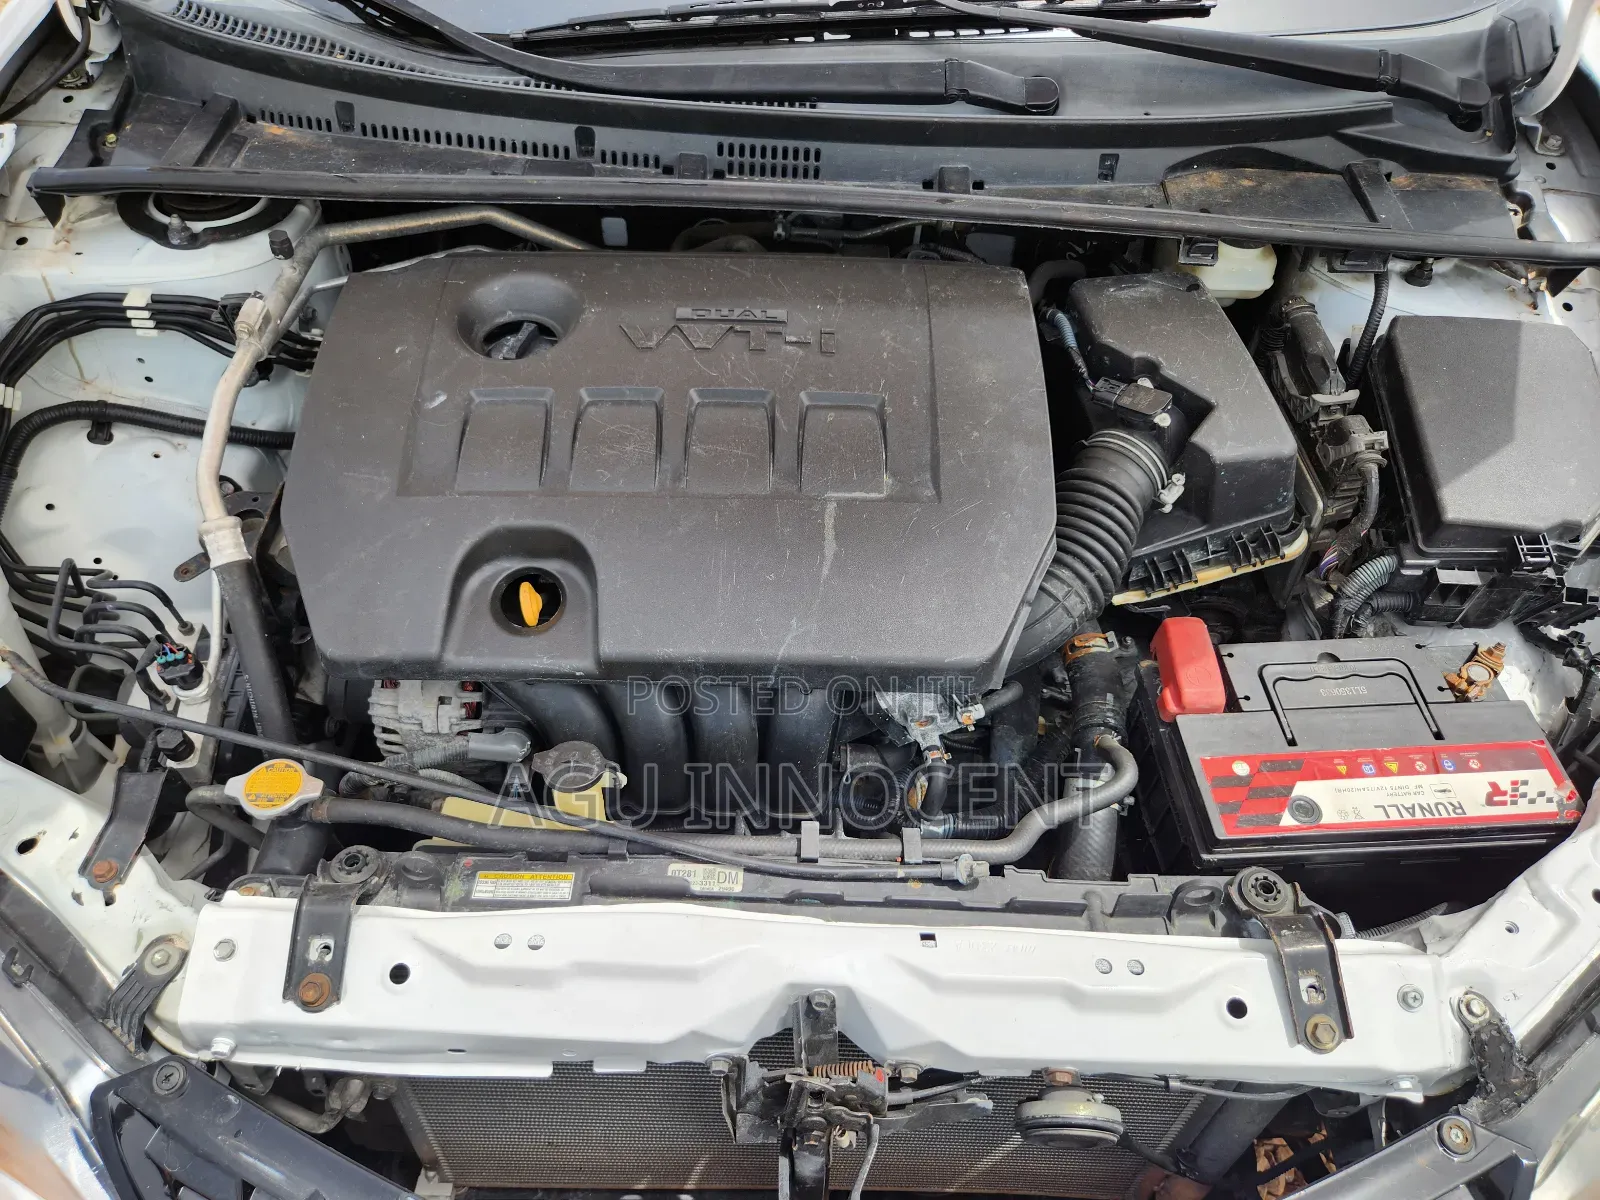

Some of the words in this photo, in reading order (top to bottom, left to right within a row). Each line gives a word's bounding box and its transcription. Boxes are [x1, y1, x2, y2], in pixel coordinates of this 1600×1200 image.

[690, 307, 779, 319] DUAL
[1373, 800, 1468, 819] RUNALL
[717, 871, 739, 885] DM
